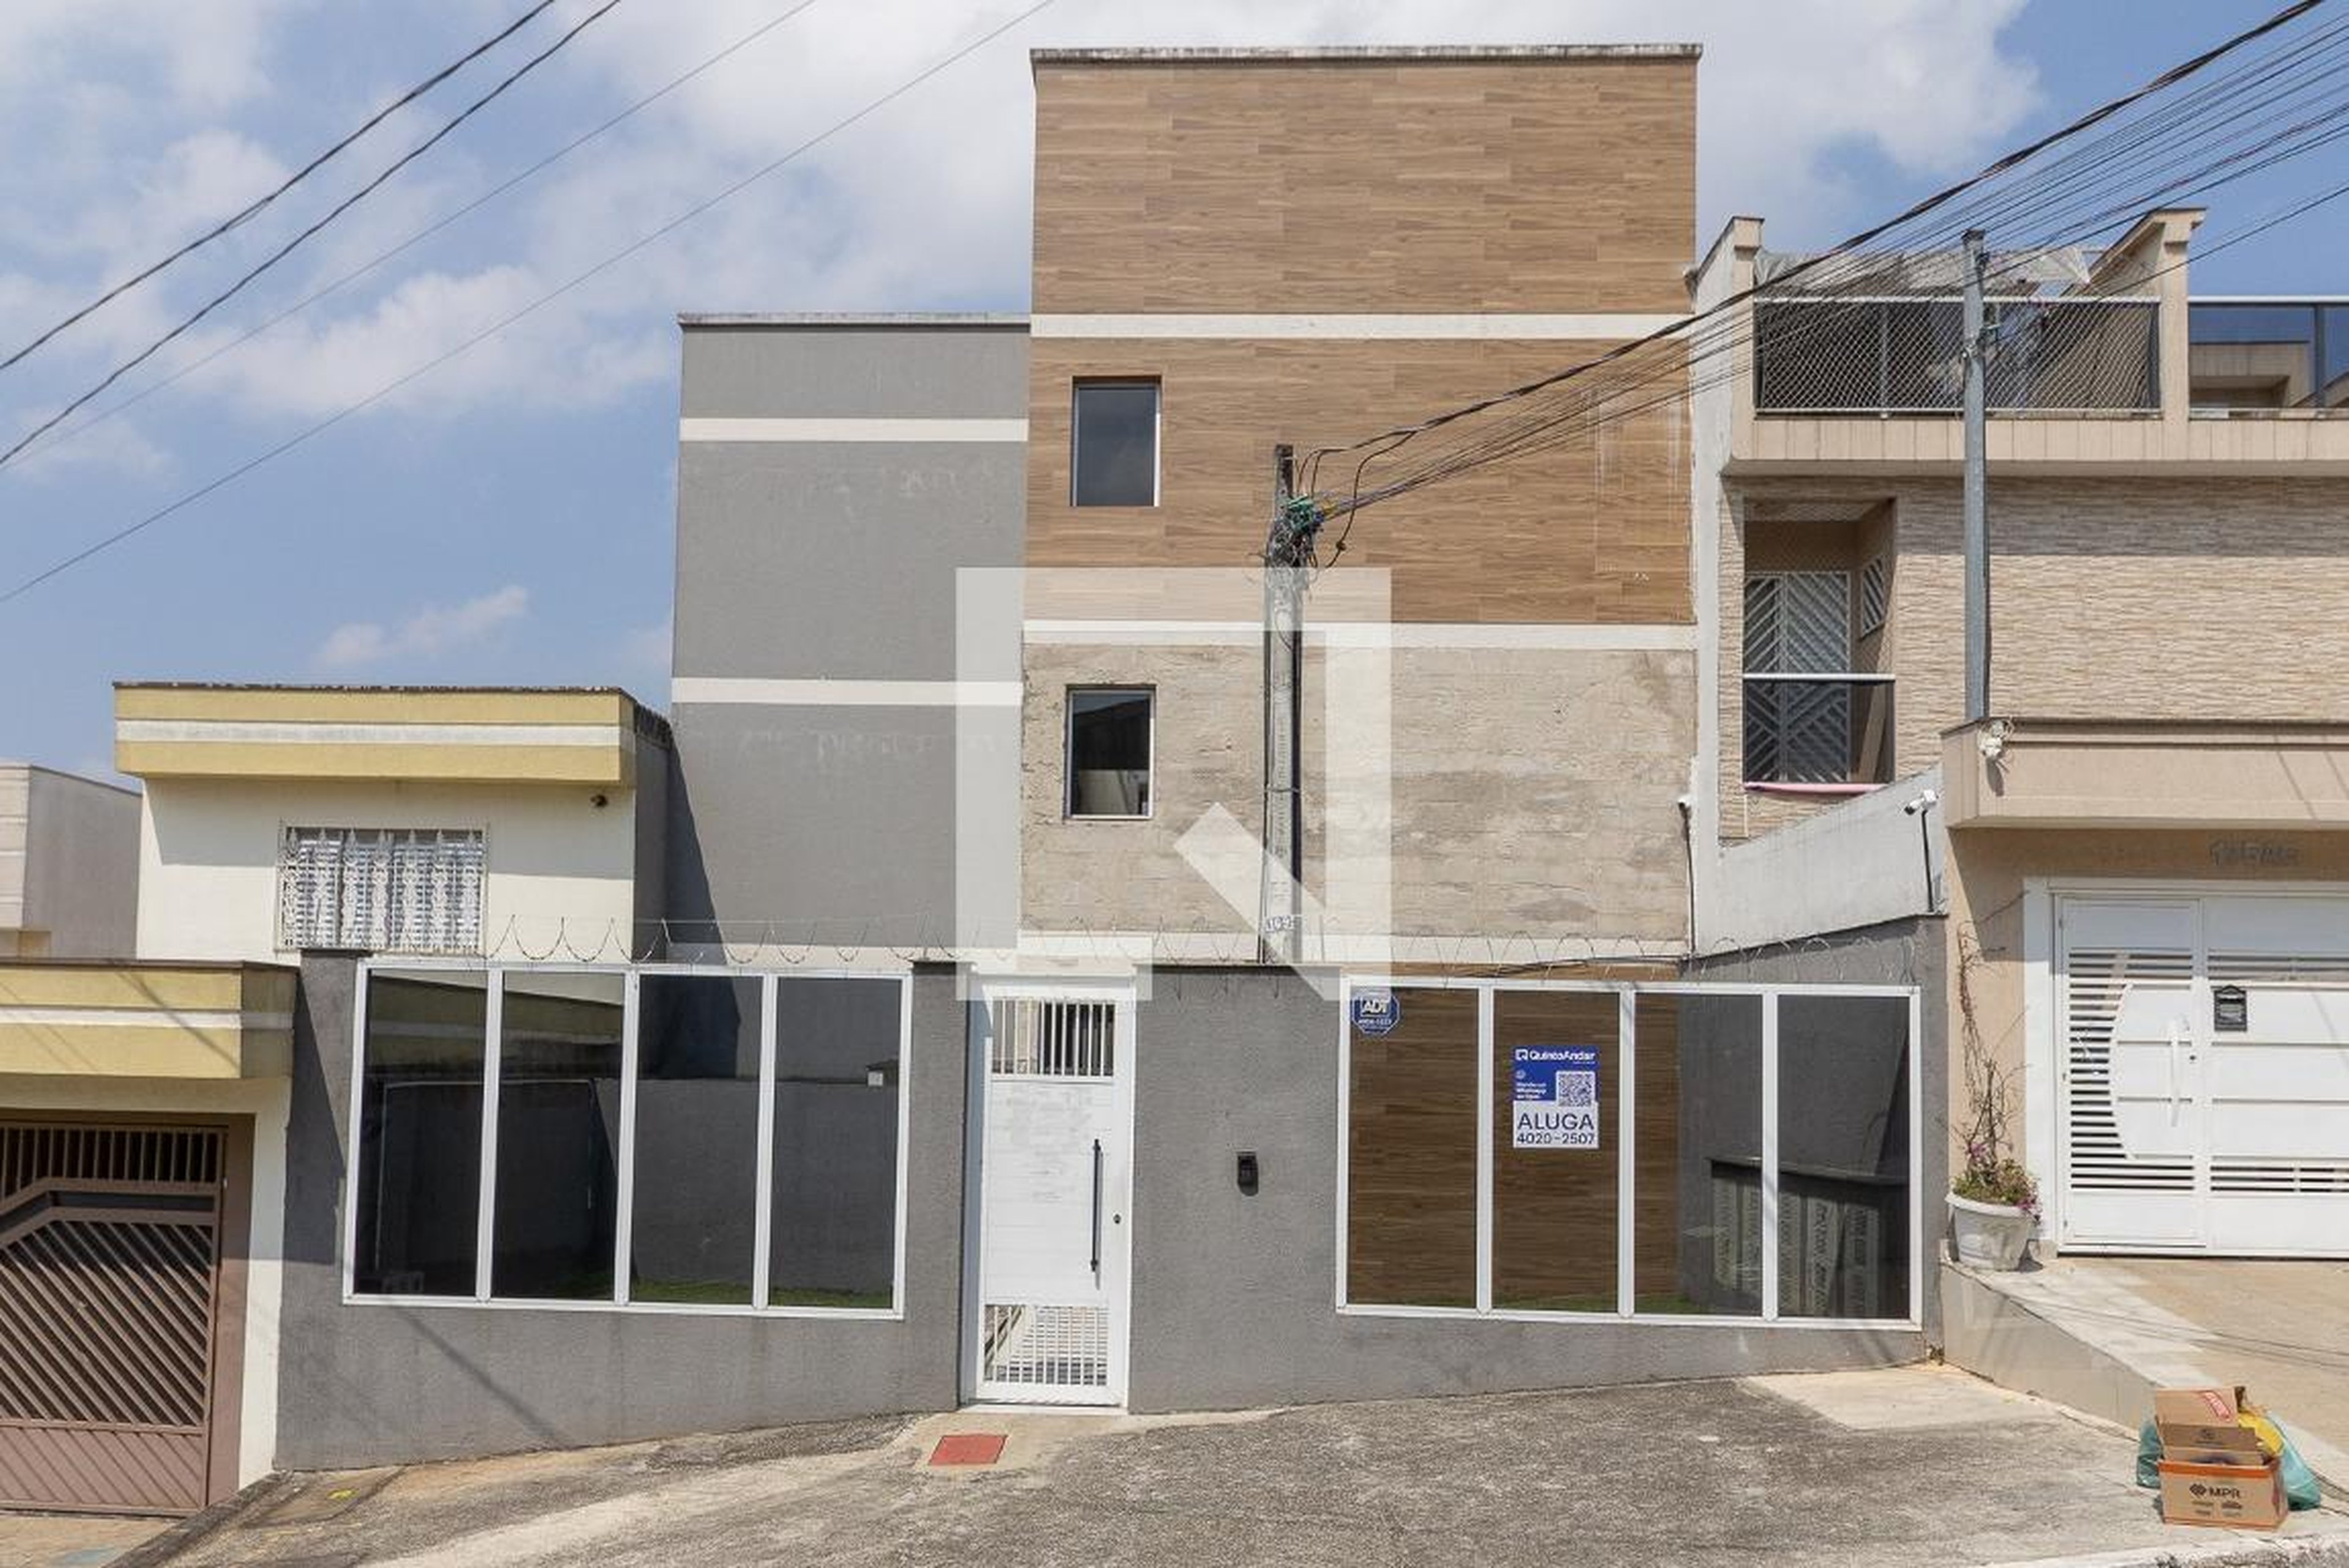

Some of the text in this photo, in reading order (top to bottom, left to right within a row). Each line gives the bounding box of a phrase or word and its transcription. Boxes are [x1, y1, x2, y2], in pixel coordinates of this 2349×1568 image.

[1363, 999, 1389, 1013] ADT
[1529, 1049, 1595, 1061] QuintoAndar
[1517, 1112, 1594, 1130] ALUGA
[1517, 1133, 1595, 1144] 4020-2507
